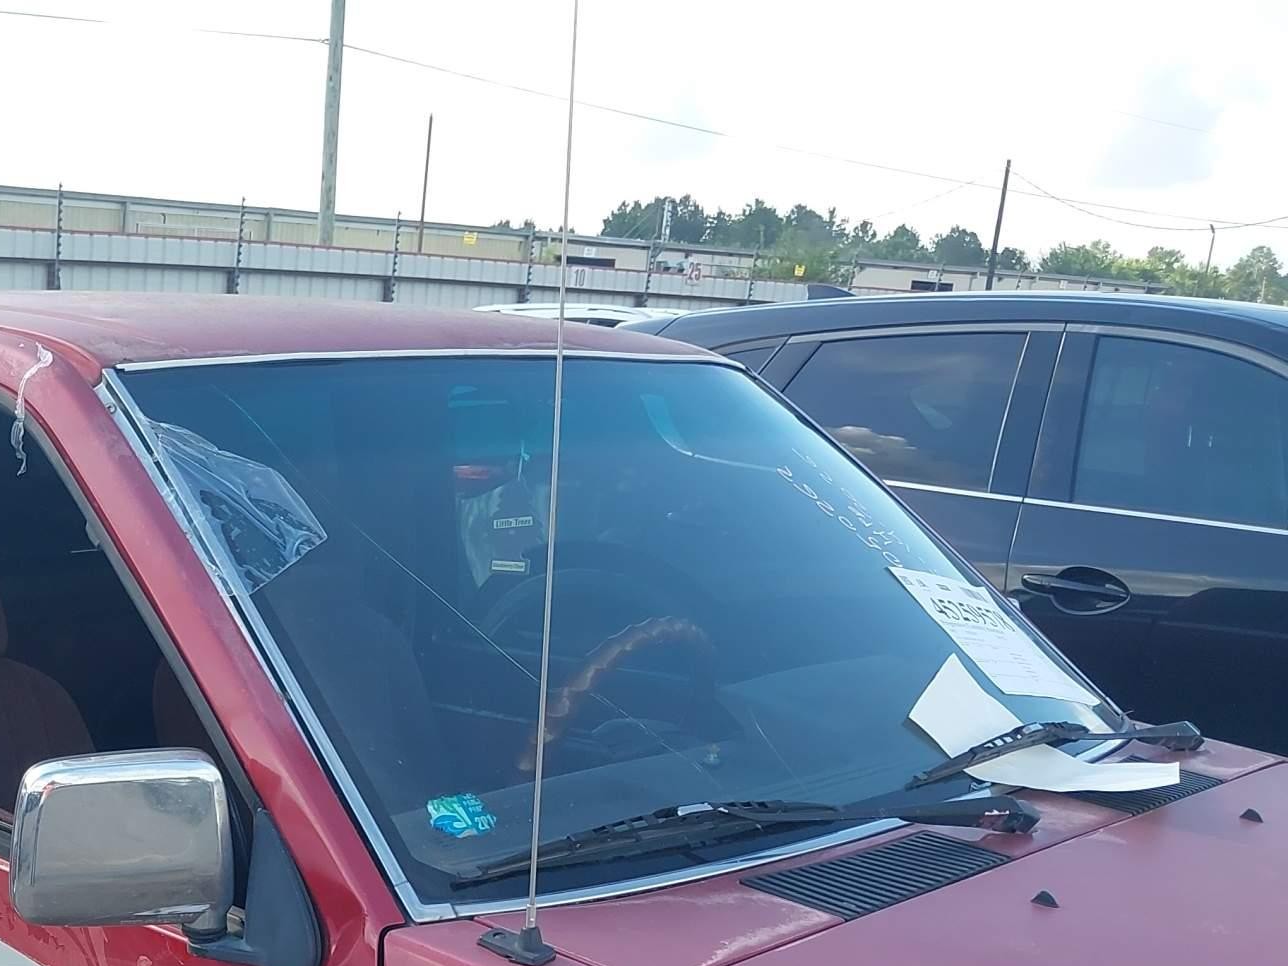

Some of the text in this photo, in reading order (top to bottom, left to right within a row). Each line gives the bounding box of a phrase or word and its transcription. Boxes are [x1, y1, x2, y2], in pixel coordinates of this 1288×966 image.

[574, 268, 586, 287] 10
[688, 262, 702, 281] 25
[929, 597, 1017, 632] 45259578
